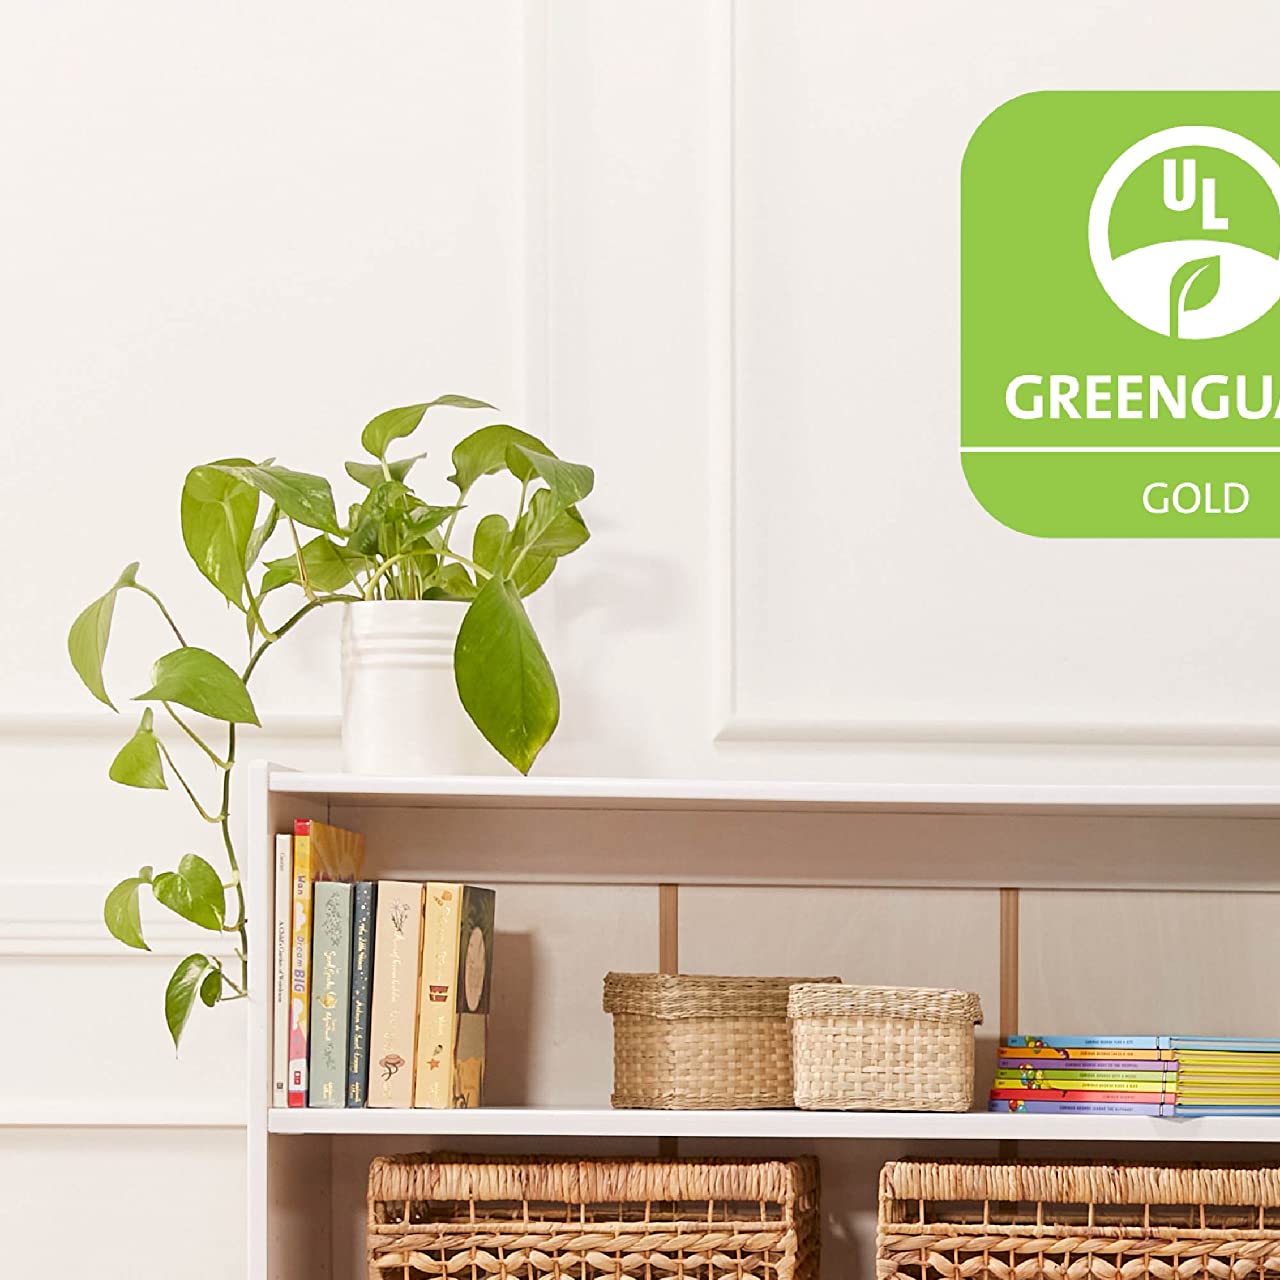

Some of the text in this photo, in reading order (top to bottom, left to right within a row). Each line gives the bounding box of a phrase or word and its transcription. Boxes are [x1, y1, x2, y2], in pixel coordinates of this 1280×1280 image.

[296, 876, 305, 895] Wan
[293, 936, 305, 992] Dream BIG
